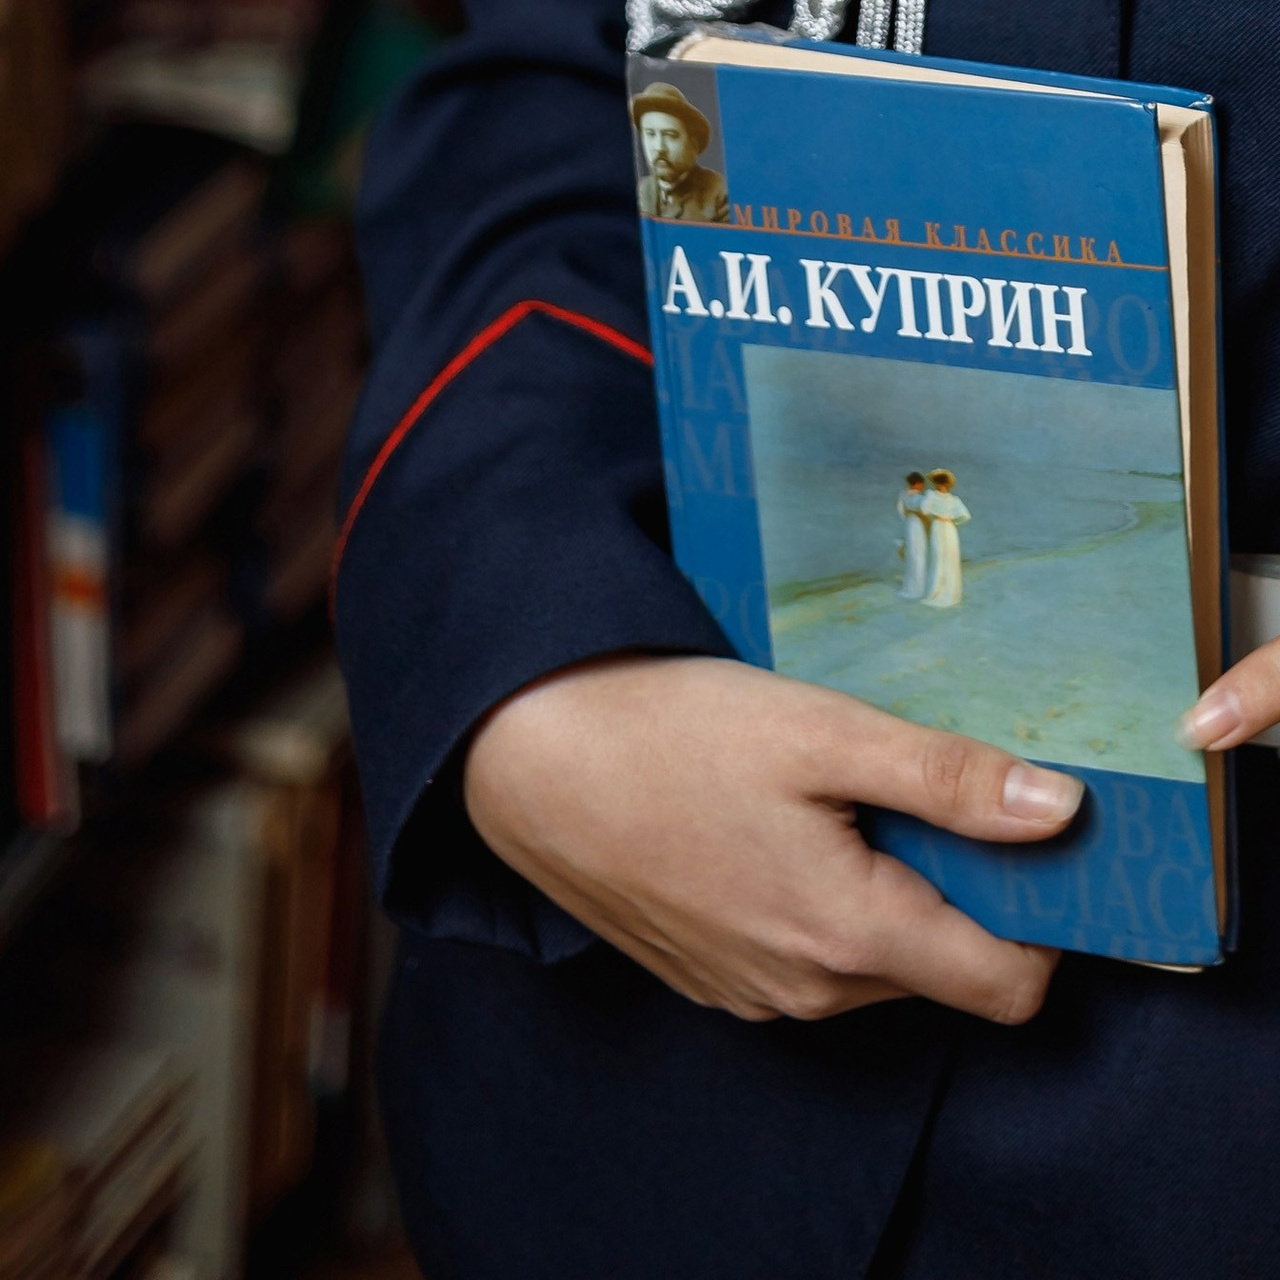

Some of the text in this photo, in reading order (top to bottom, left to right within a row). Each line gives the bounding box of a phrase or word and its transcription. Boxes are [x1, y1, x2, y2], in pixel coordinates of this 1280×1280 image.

[733, 203, 1124, 266] МИРОВАЯ КЛАССИКА
[661, 245, 1094, 357] А.И. КУПРИН
